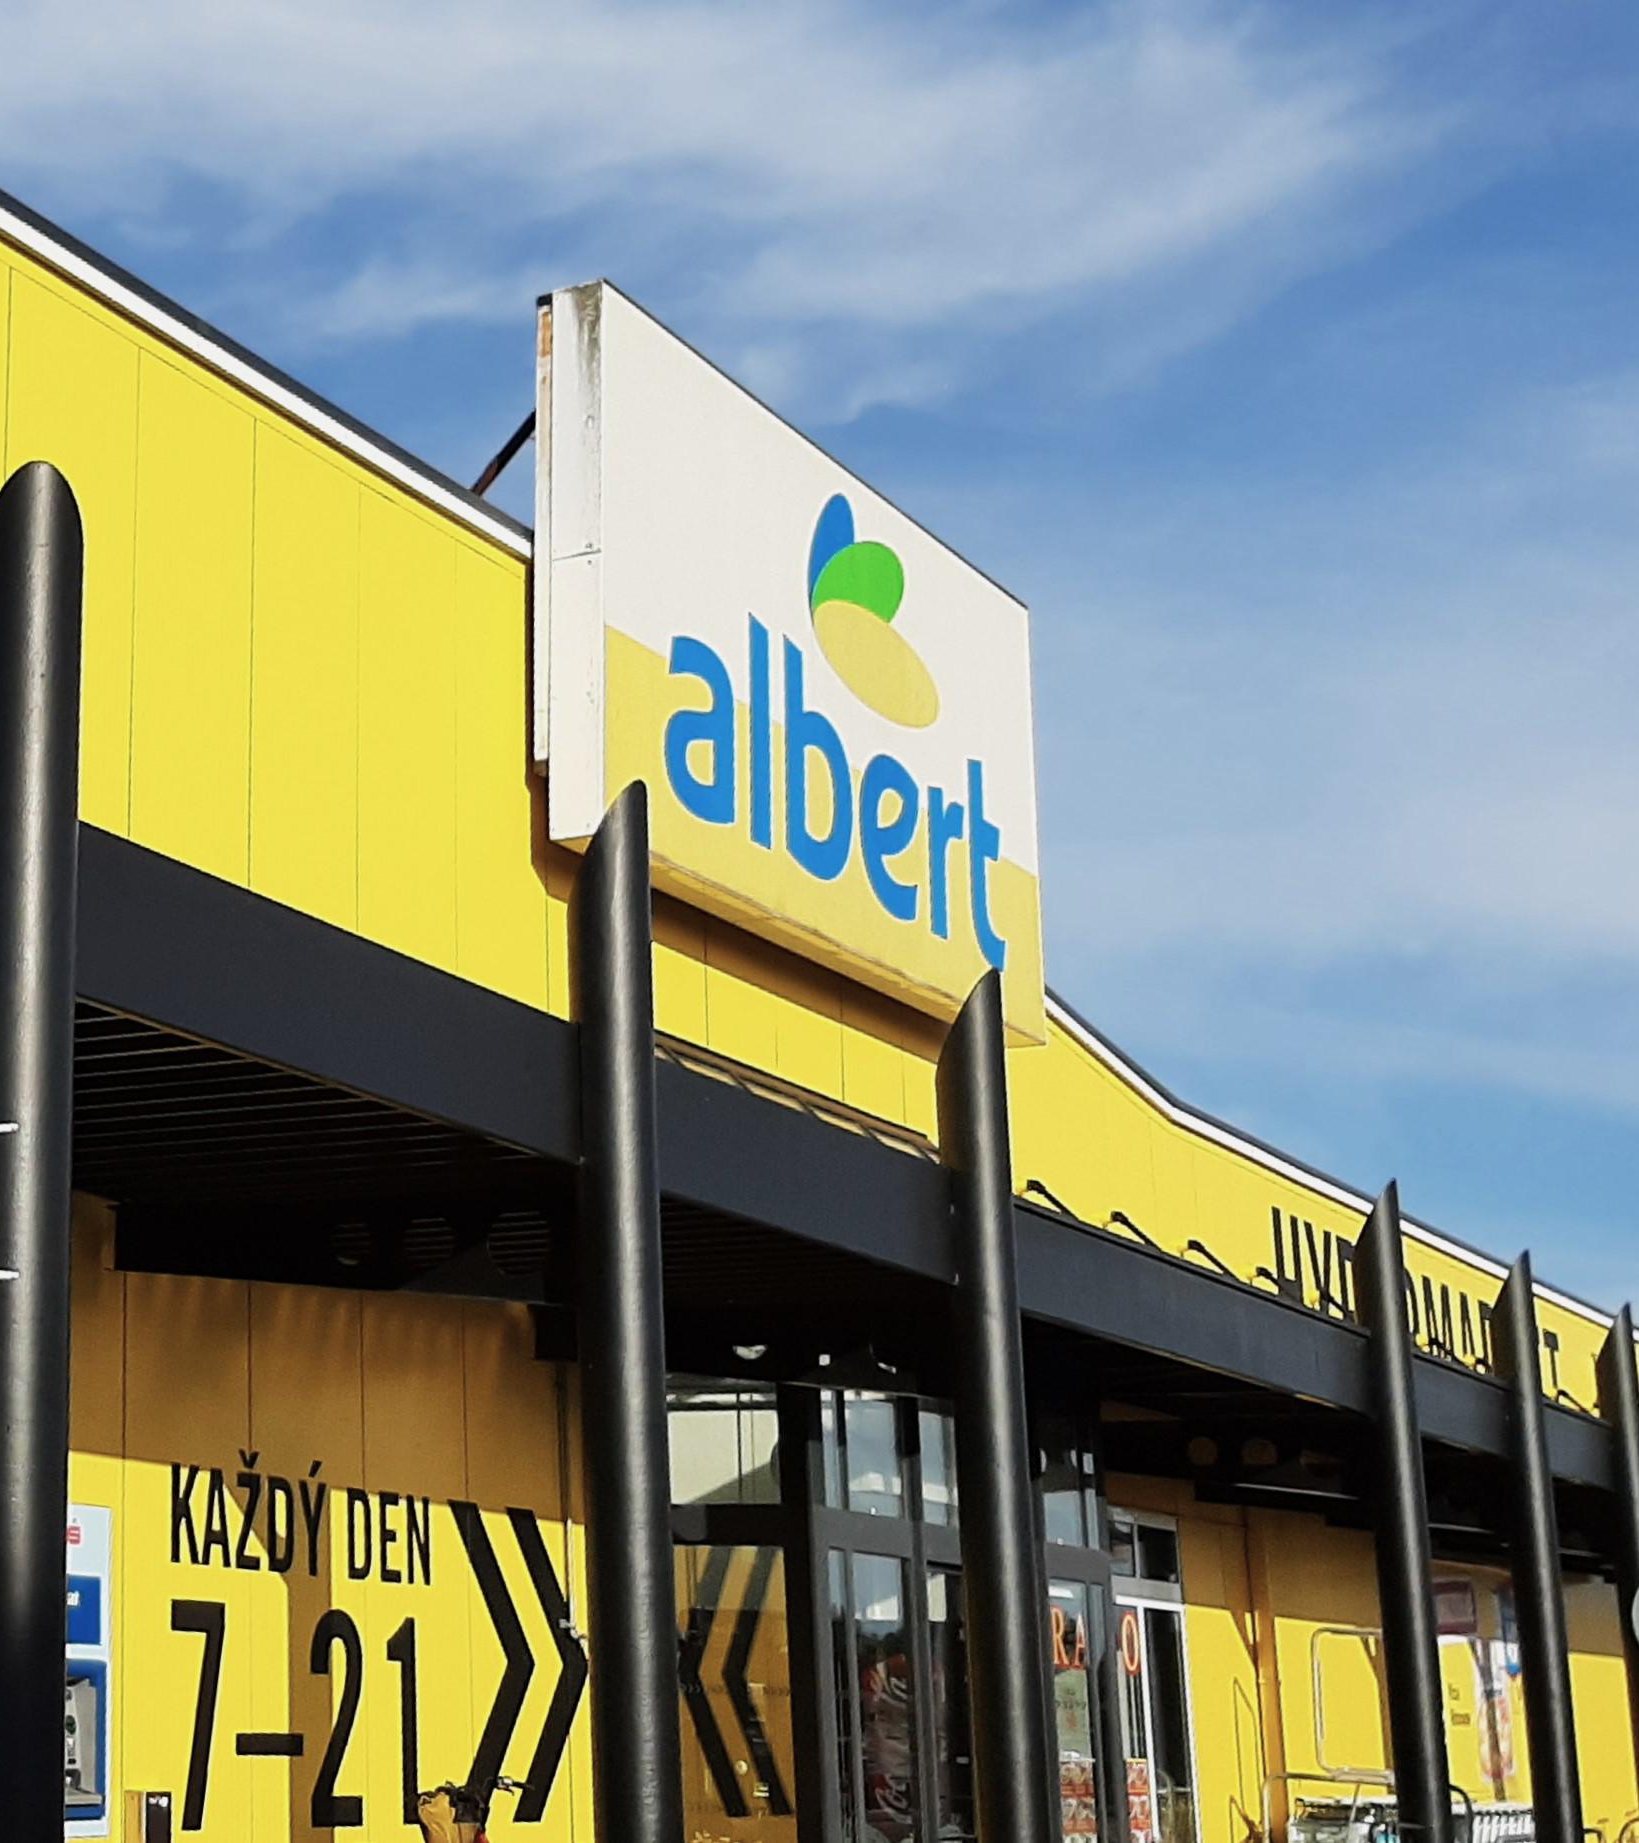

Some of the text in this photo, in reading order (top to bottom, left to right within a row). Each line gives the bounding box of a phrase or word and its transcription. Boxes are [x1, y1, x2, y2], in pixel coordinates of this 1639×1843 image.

[664, 612, 1006, 972] albert
[171, 1449, 431, 1587] KAŽDÝ DEN
